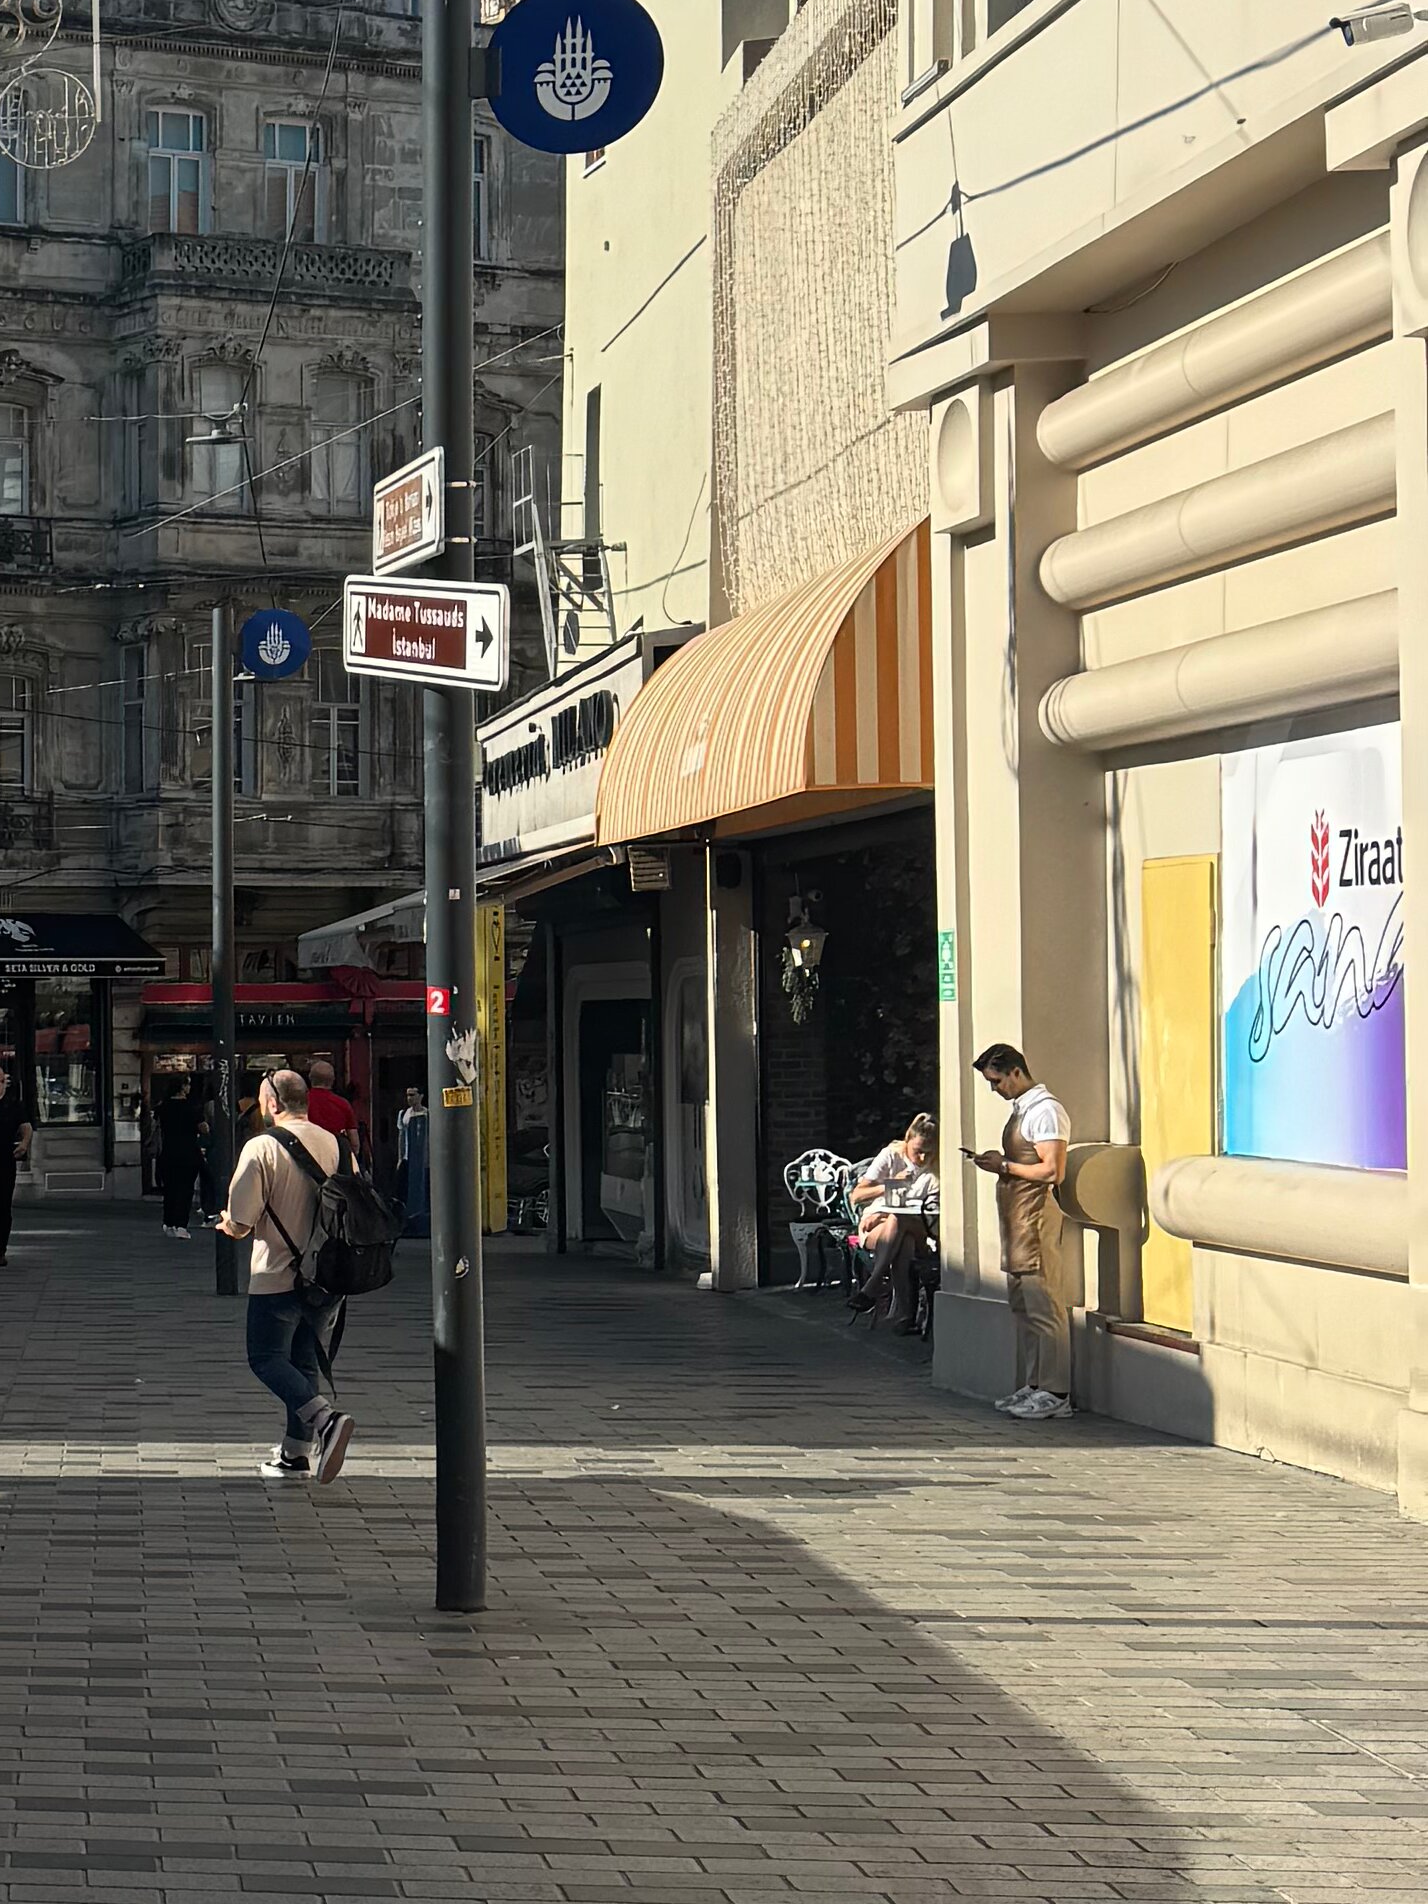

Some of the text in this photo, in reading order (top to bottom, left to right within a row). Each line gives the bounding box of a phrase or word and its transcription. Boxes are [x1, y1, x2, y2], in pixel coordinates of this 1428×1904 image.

[367, 597, 465, 629] Madame Tussauds
[392, 627, 436, 660] İstanbul
[1338, 826, 1404, 887] Ziraat
[430, 990, 445, 1013] 2
